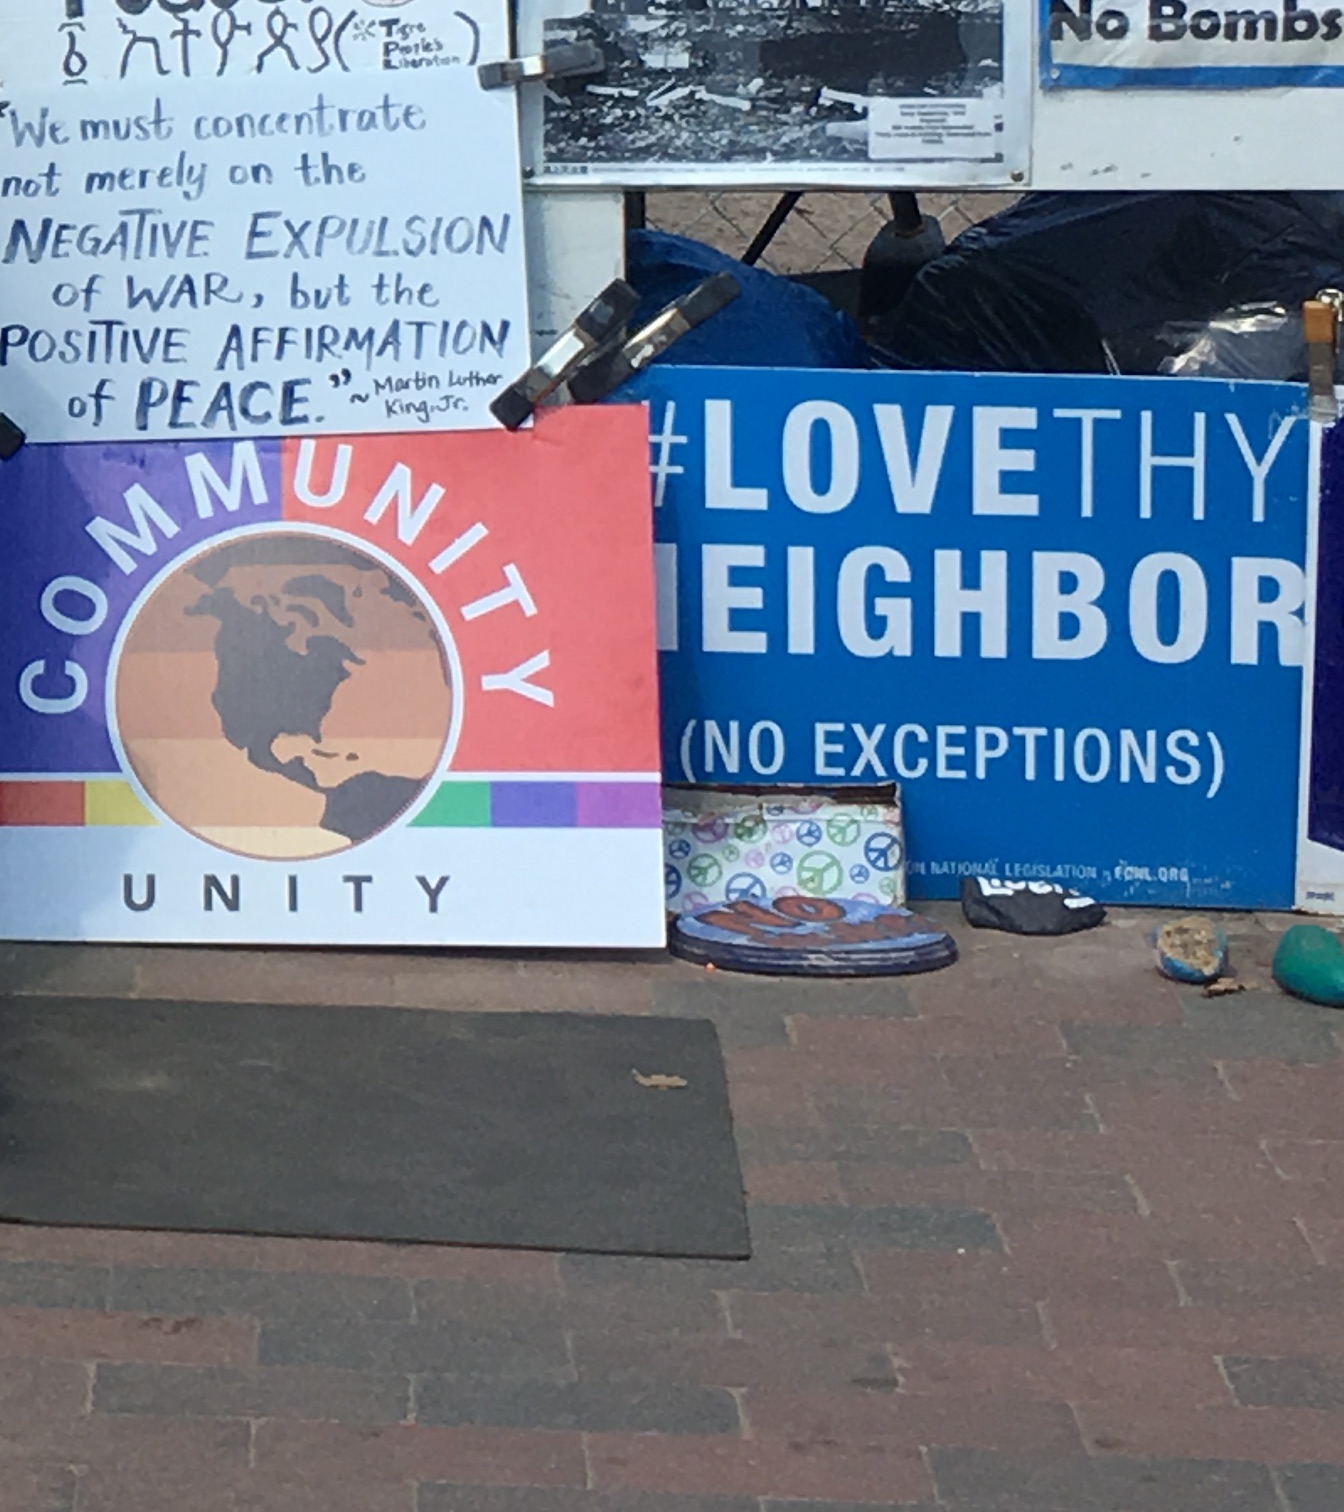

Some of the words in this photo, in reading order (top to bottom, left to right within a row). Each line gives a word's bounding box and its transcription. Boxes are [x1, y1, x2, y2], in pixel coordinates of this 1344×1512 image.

[80, 98, 174, 142] must
[193, 93, 427, 140] concentrate
[1, 162, 61, 199] not
[85, 151, 209, 200] merely
[229, 160, 274, 186] on
[295, 152, 368, 186] the
[0, 208, 216, 264] NEGATIVE
[244, 210, 511, 262] EXPULSION
[52, 273, 105, 313] of
[126, 271, 265, 313] WAR,
[290, 271, 351, 308] but
[372, 272, 442, 308] the
[214, 318, 511, 372] AFFIRMATION
[67, 377, 116, 420] of
[373, 371, 440, 396] Martin
[448, 369, 504, 388] Luther
[648, 398, 1297, 522] #LOVETHY
[18, 437, 557, 716] COMMUNITY
[680, 719, 786, 784] (NO
[814, 722, 1226, 799] EXCEPTIONS)
[930, 859, 999, 877] NATIONAL
[1004, 862, 1098, 880] LEGISLATION
[121, 874, 452, 915] UNITY
